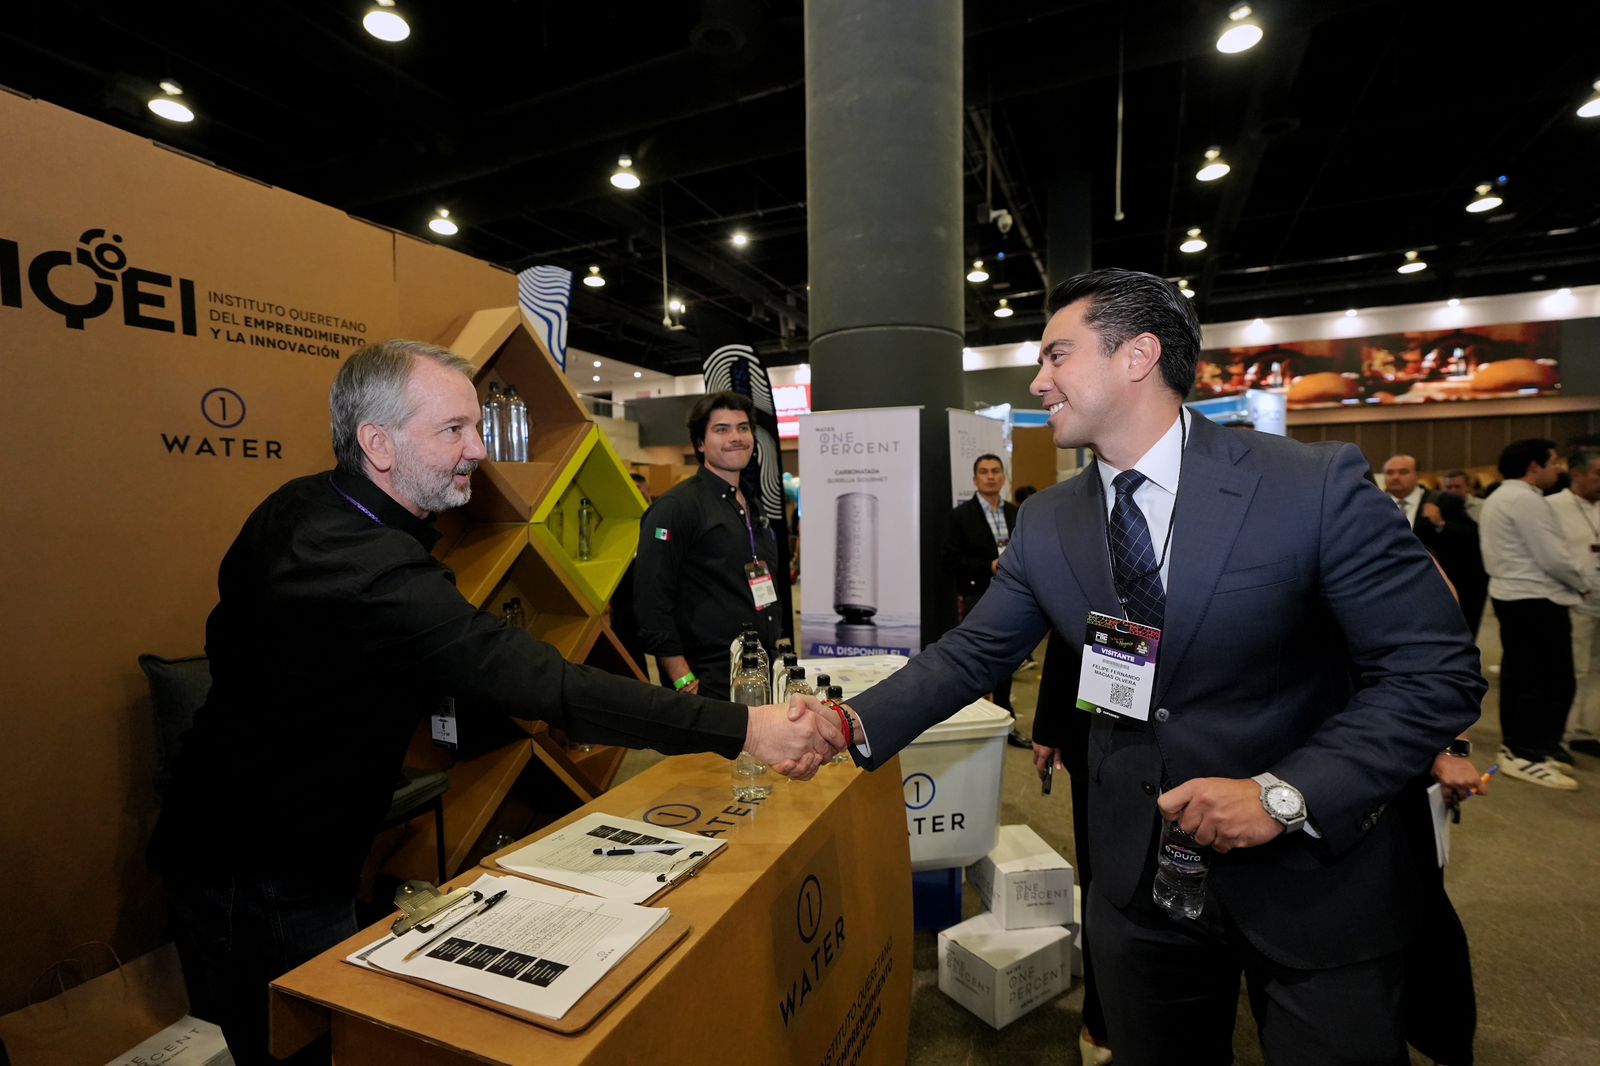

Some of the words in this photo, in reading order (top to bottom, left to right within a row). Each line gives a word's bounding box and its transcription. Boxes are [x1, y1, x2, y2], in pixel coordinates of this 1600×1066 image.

[208, 291, 286, 317] INSTITUTO
[289, 308, 367, 334] QUERETANO
[209, 309, 239, 326] DEL
[244, 316, 367, 347] EMPRENDIMIENTO
[210, 327, 221, 339] Y
[226, 330, 246, 344] LA
[250, 334, 340, 359] INNOVACIÓN
[160, 433, 282, 459] WATER
[820, 441, 900, 455] PERCENT
[1101, 647, 1135, 663] VISITANTE
[1092, 663, 1109, 673] FELIPE
[1110, 667, 1141, 682] FERNANDO
[908, 812, 965, 835] TER
[1016, 889, 1069, 901] PERCENT
[779, 915, 845, 1028] WATER
[1009, 963, 1066, 1005] PERCENT
